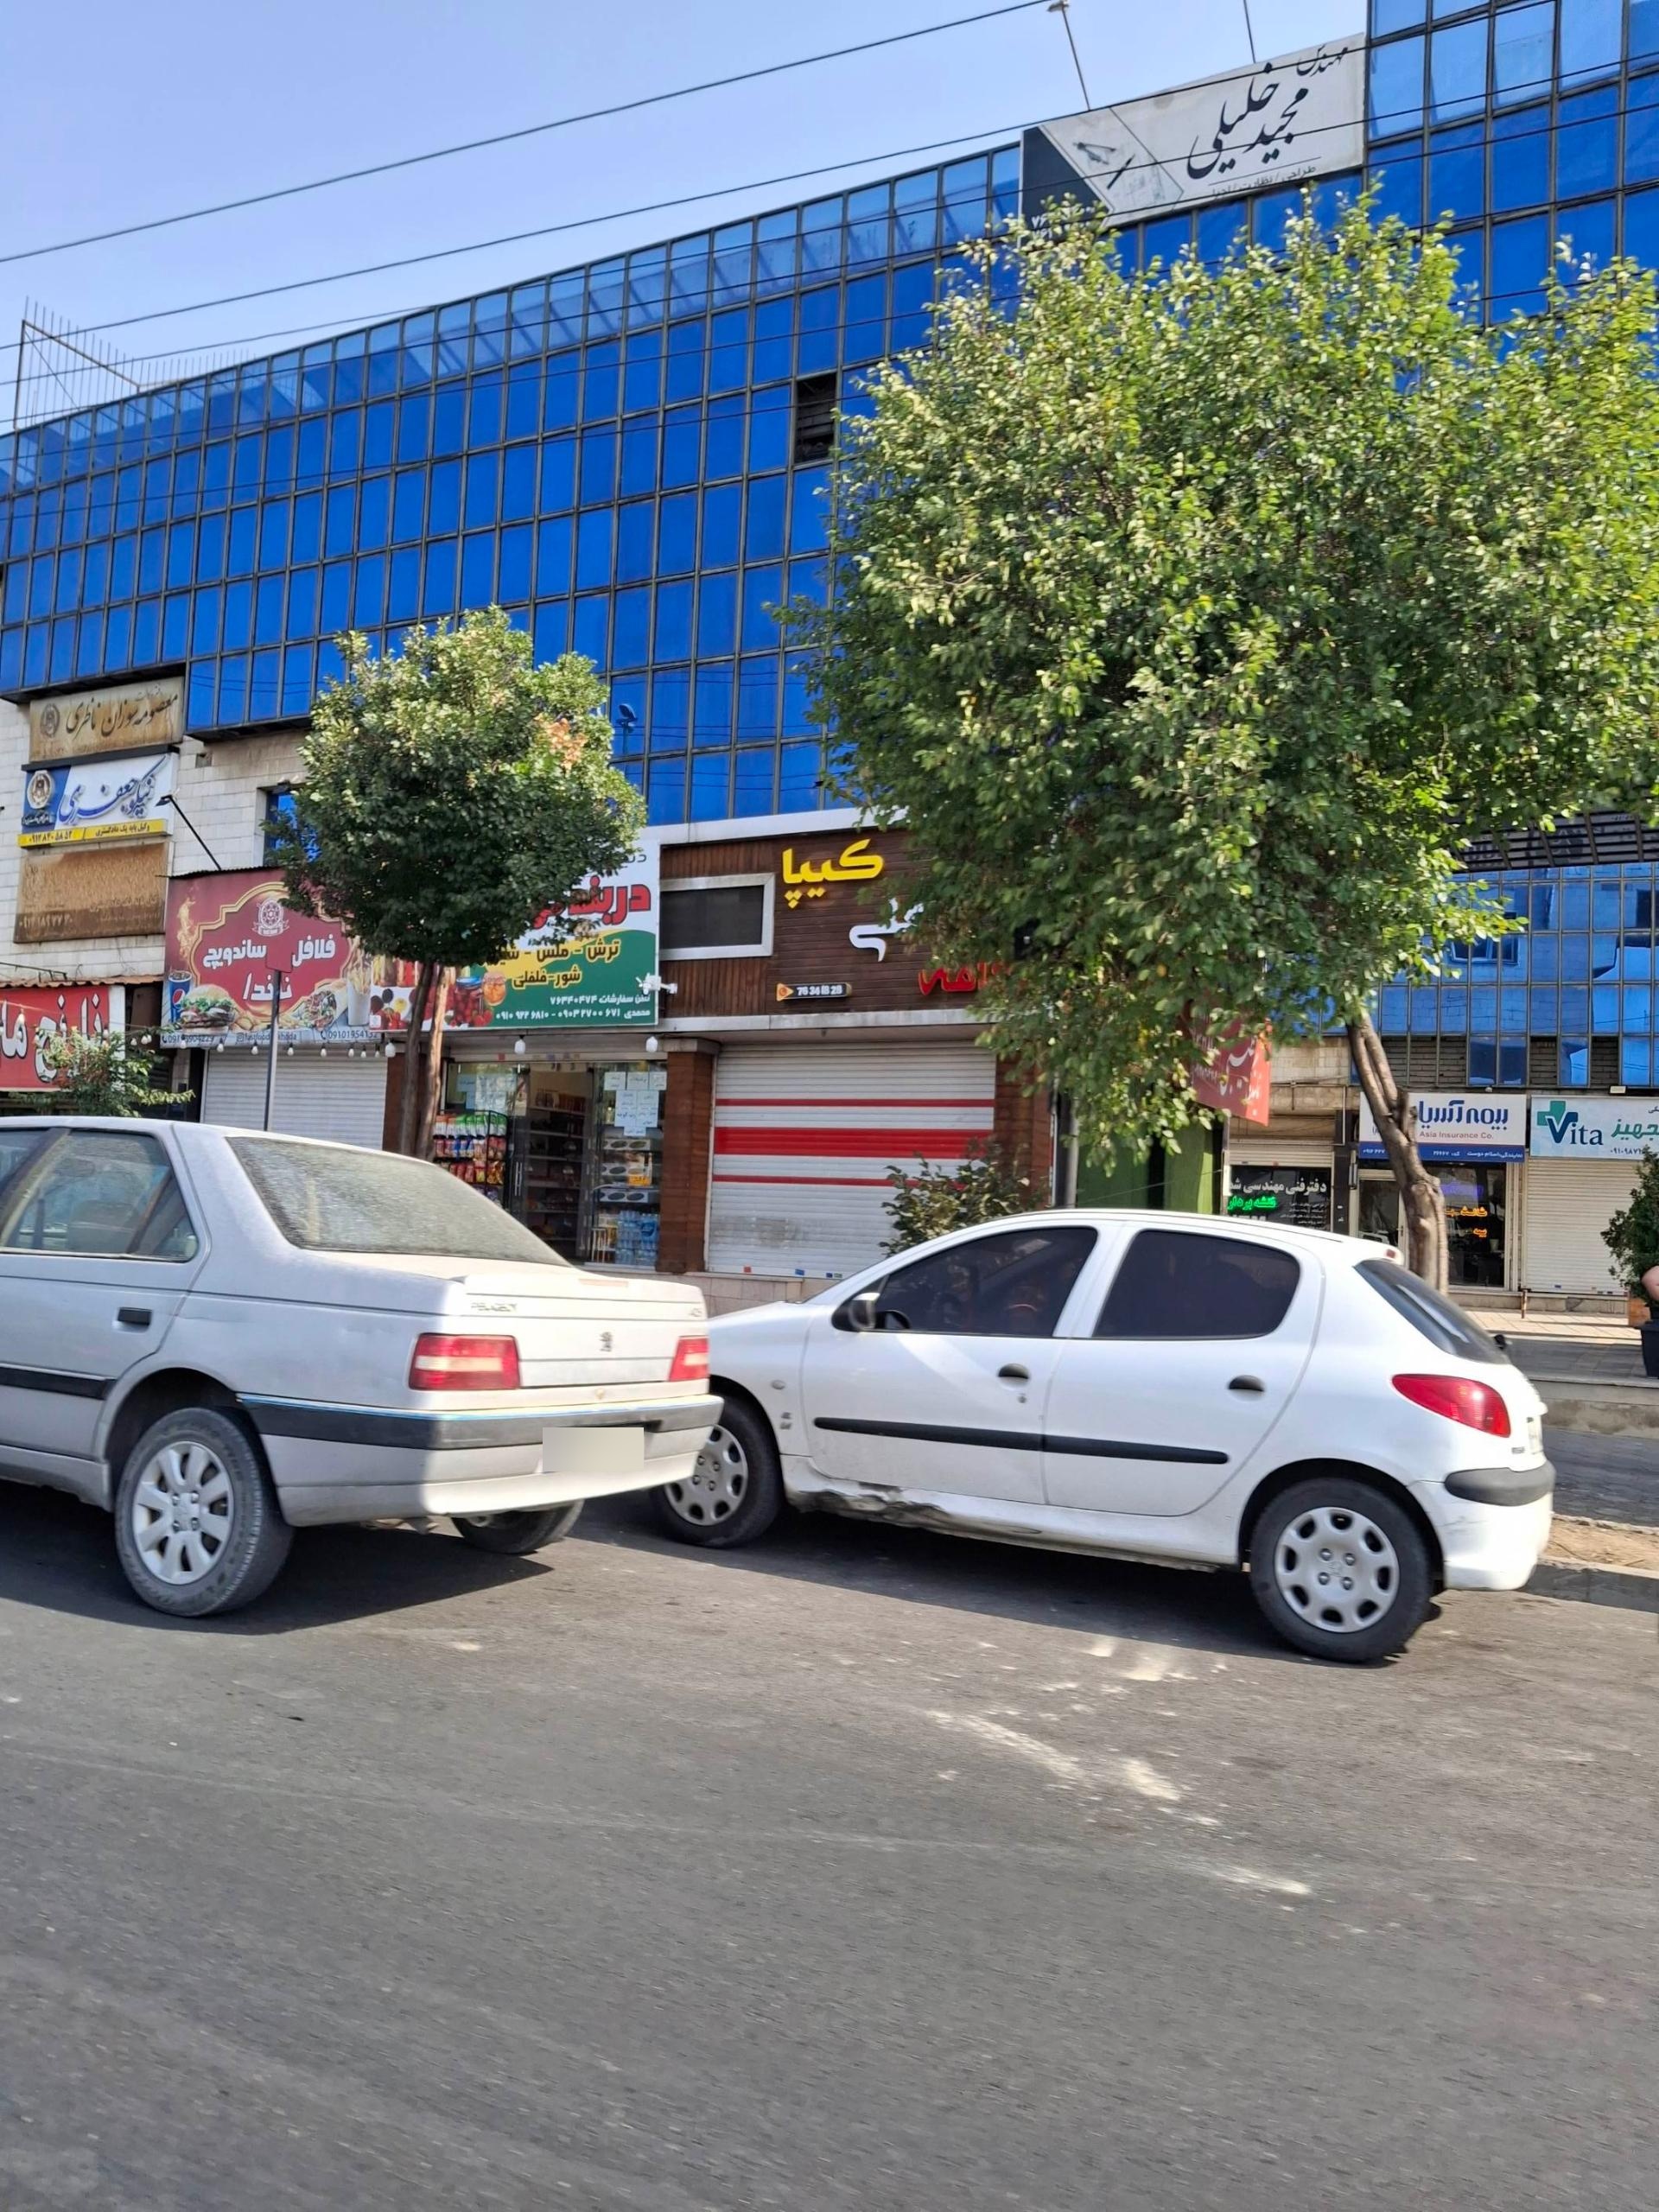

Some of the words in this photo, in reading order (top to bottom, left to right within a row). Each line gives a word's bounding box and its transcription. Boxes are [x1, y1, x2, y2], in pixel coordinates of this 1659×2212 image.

[1296, 44, 1348, 77] مهندس
[1186, 62, 1281, 180] خلیلی
[1243, 87, 1309, 163] مجید
[58, 778, 138, 823] جعفری
[782, 838, 884, 908] کیپا
[292, 933, 336, 967] فلافل
[537, 944, 569, 962] ملس
[588, 938, 620, 960] ترش
[598, 993, 633, 1005] سفارشات
[624, 1009, 651, 1019] محمدی
[1419, 1100, 1465, 1129] آسیا
[1466, 1107, 1509, 1131] بیمه
[1439, 1131, 1478, 1140] Insurance
[1547, 1111, 1604, 1146] Vita
[1611, 1118, 1659, 1141] جهیز
[1243, 1180, 1285, 1193] مهندسی
[1285, 1177, 1306, 1195] فنی
[1304, 1178, 1327, 1196] دفتر
